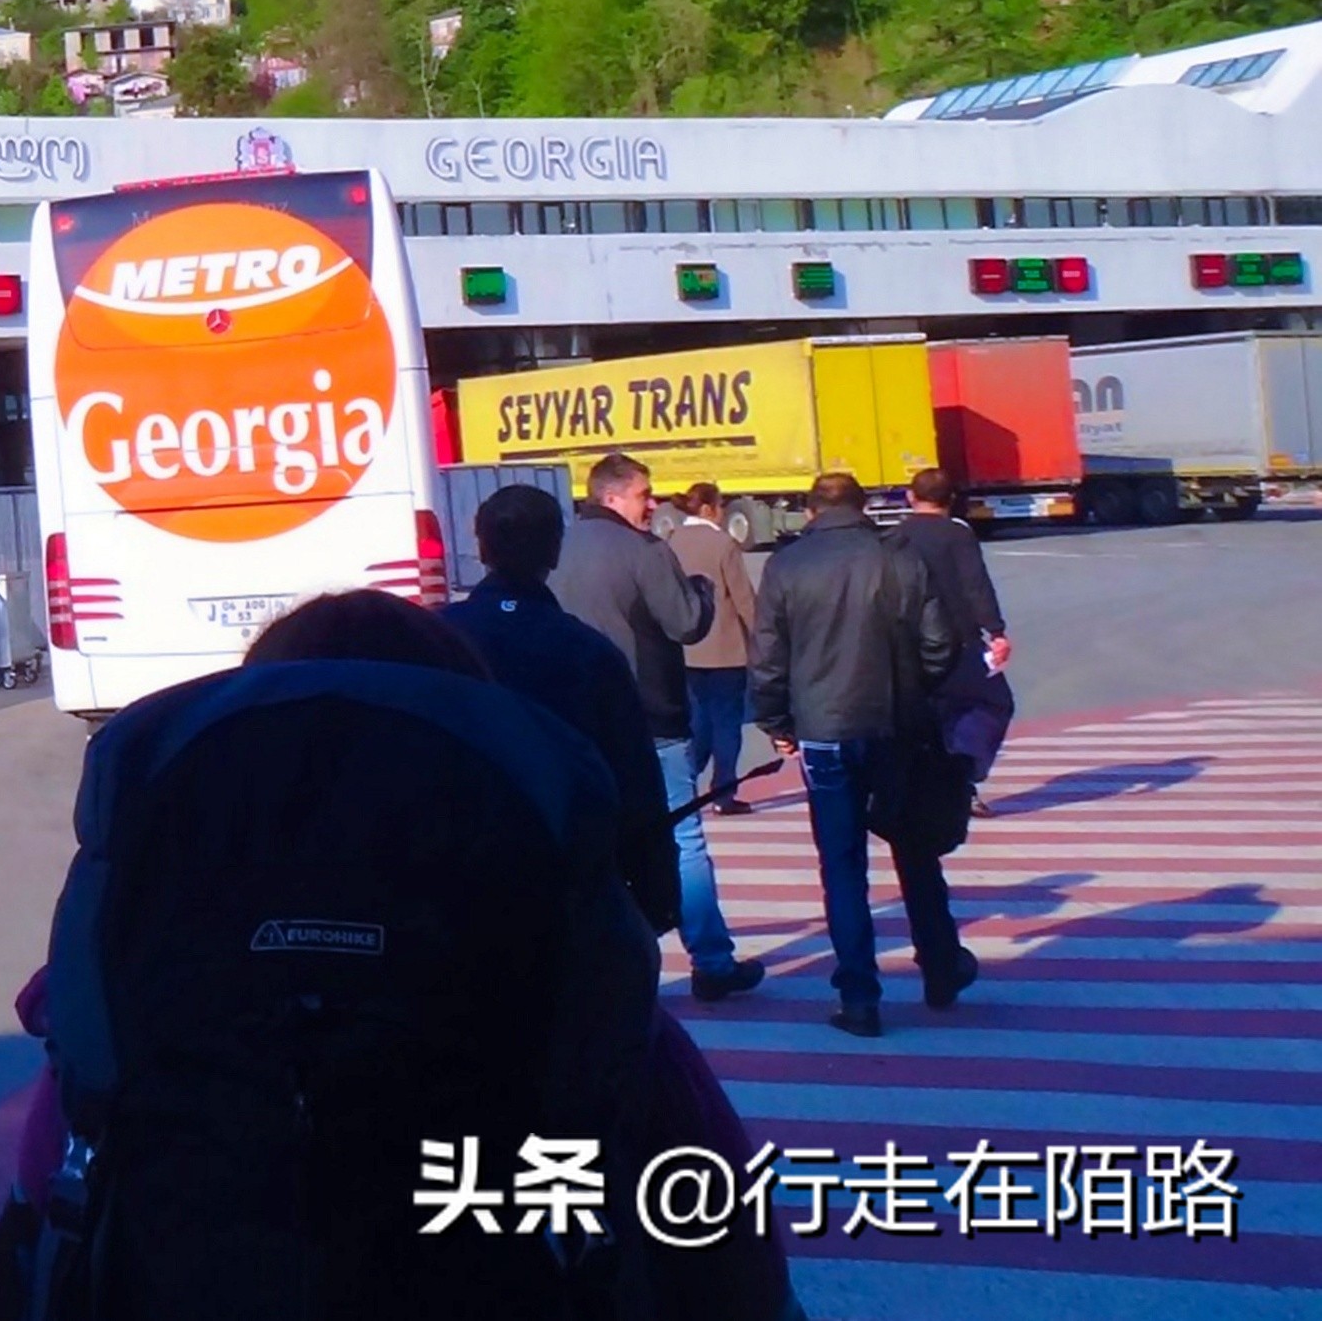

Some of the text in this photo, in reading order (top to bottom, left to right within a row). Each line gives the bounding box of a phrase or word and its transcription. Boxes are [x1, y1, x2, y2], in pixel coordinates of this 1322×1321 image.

[425, 135, 668, 182] GEORGIA
[109, 244, 323, 300] METRO
[66, 369, 385, 495] Georgia
[497, 369, 753, 444] SEYYAR TRANS
[286, 927, 377, 947] EUROHIKE
